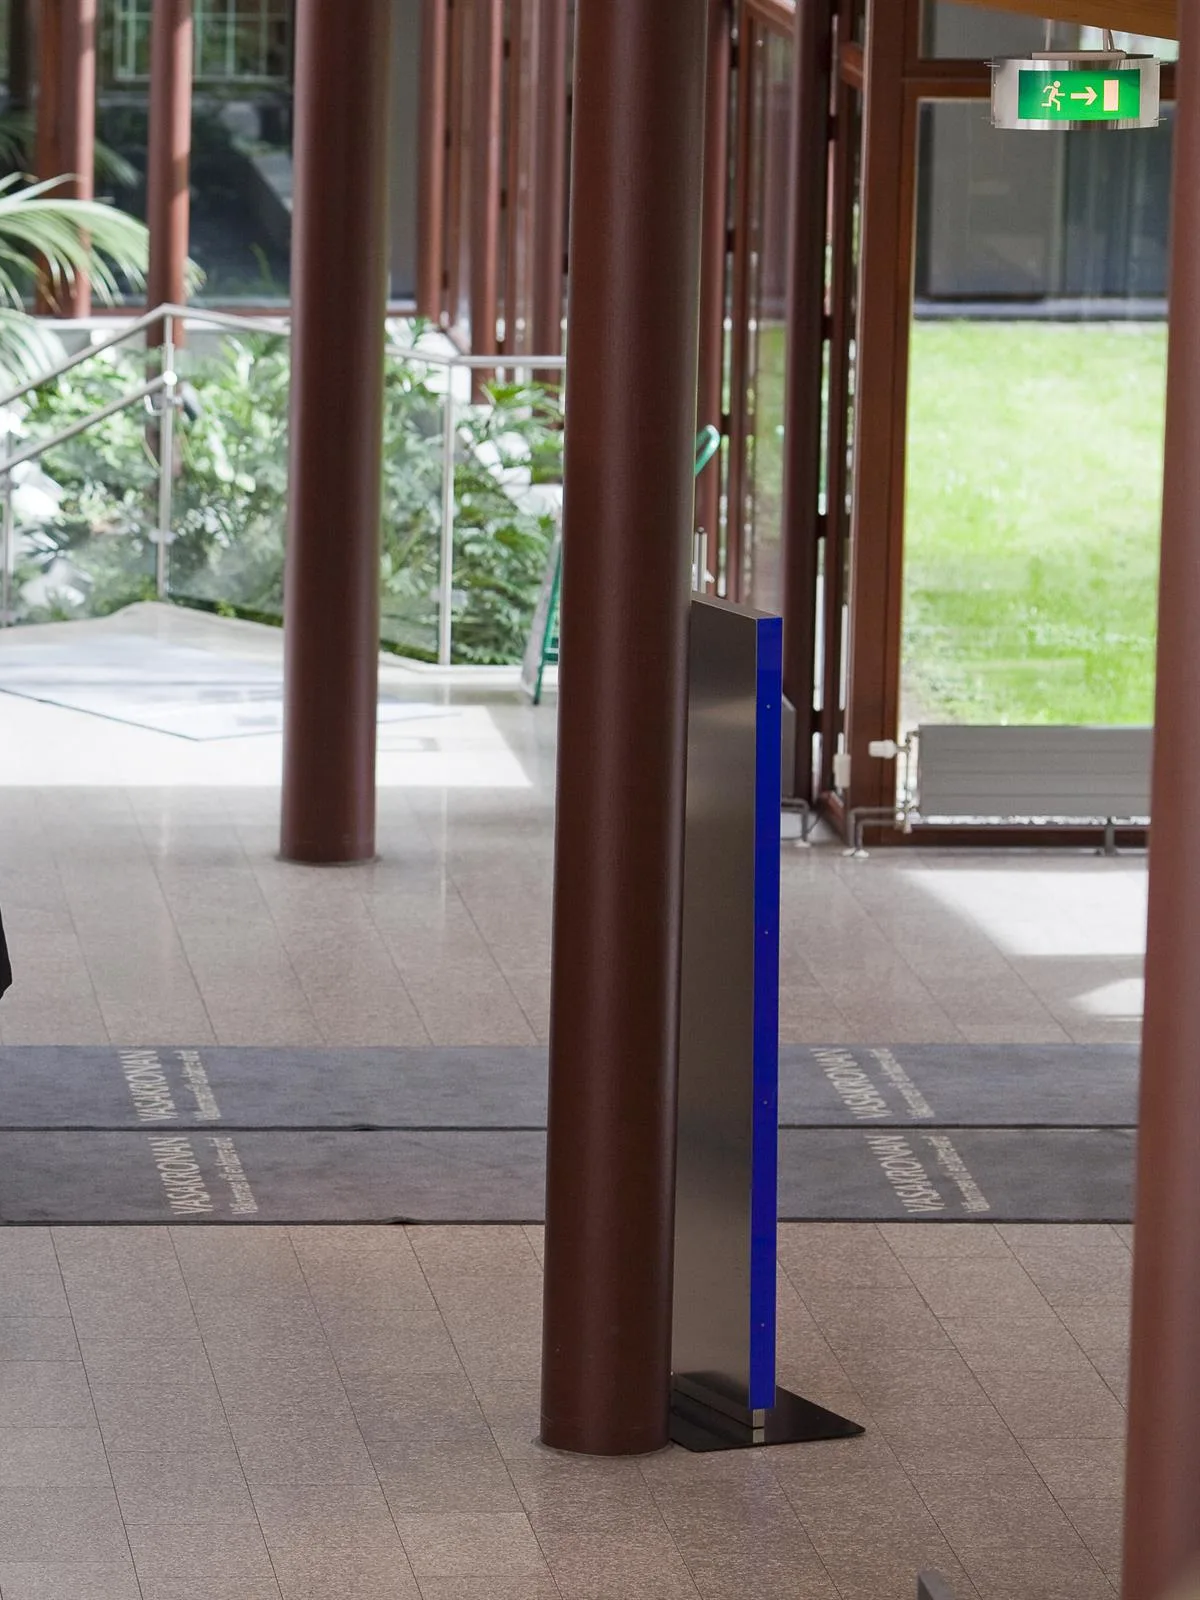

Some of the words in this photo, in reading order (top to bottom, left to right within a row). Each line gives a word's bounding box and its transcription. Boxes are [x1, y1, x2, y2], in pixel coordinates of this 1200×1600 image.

[118, 1050, 179, 1122] VASAKRONAN
[810, 1048, 893, 1119] VASAKRONAN
[147, 1136, 214, 1215] VASAKRONAN
[864, 1136, 947, 1213] VASAKRONAN
